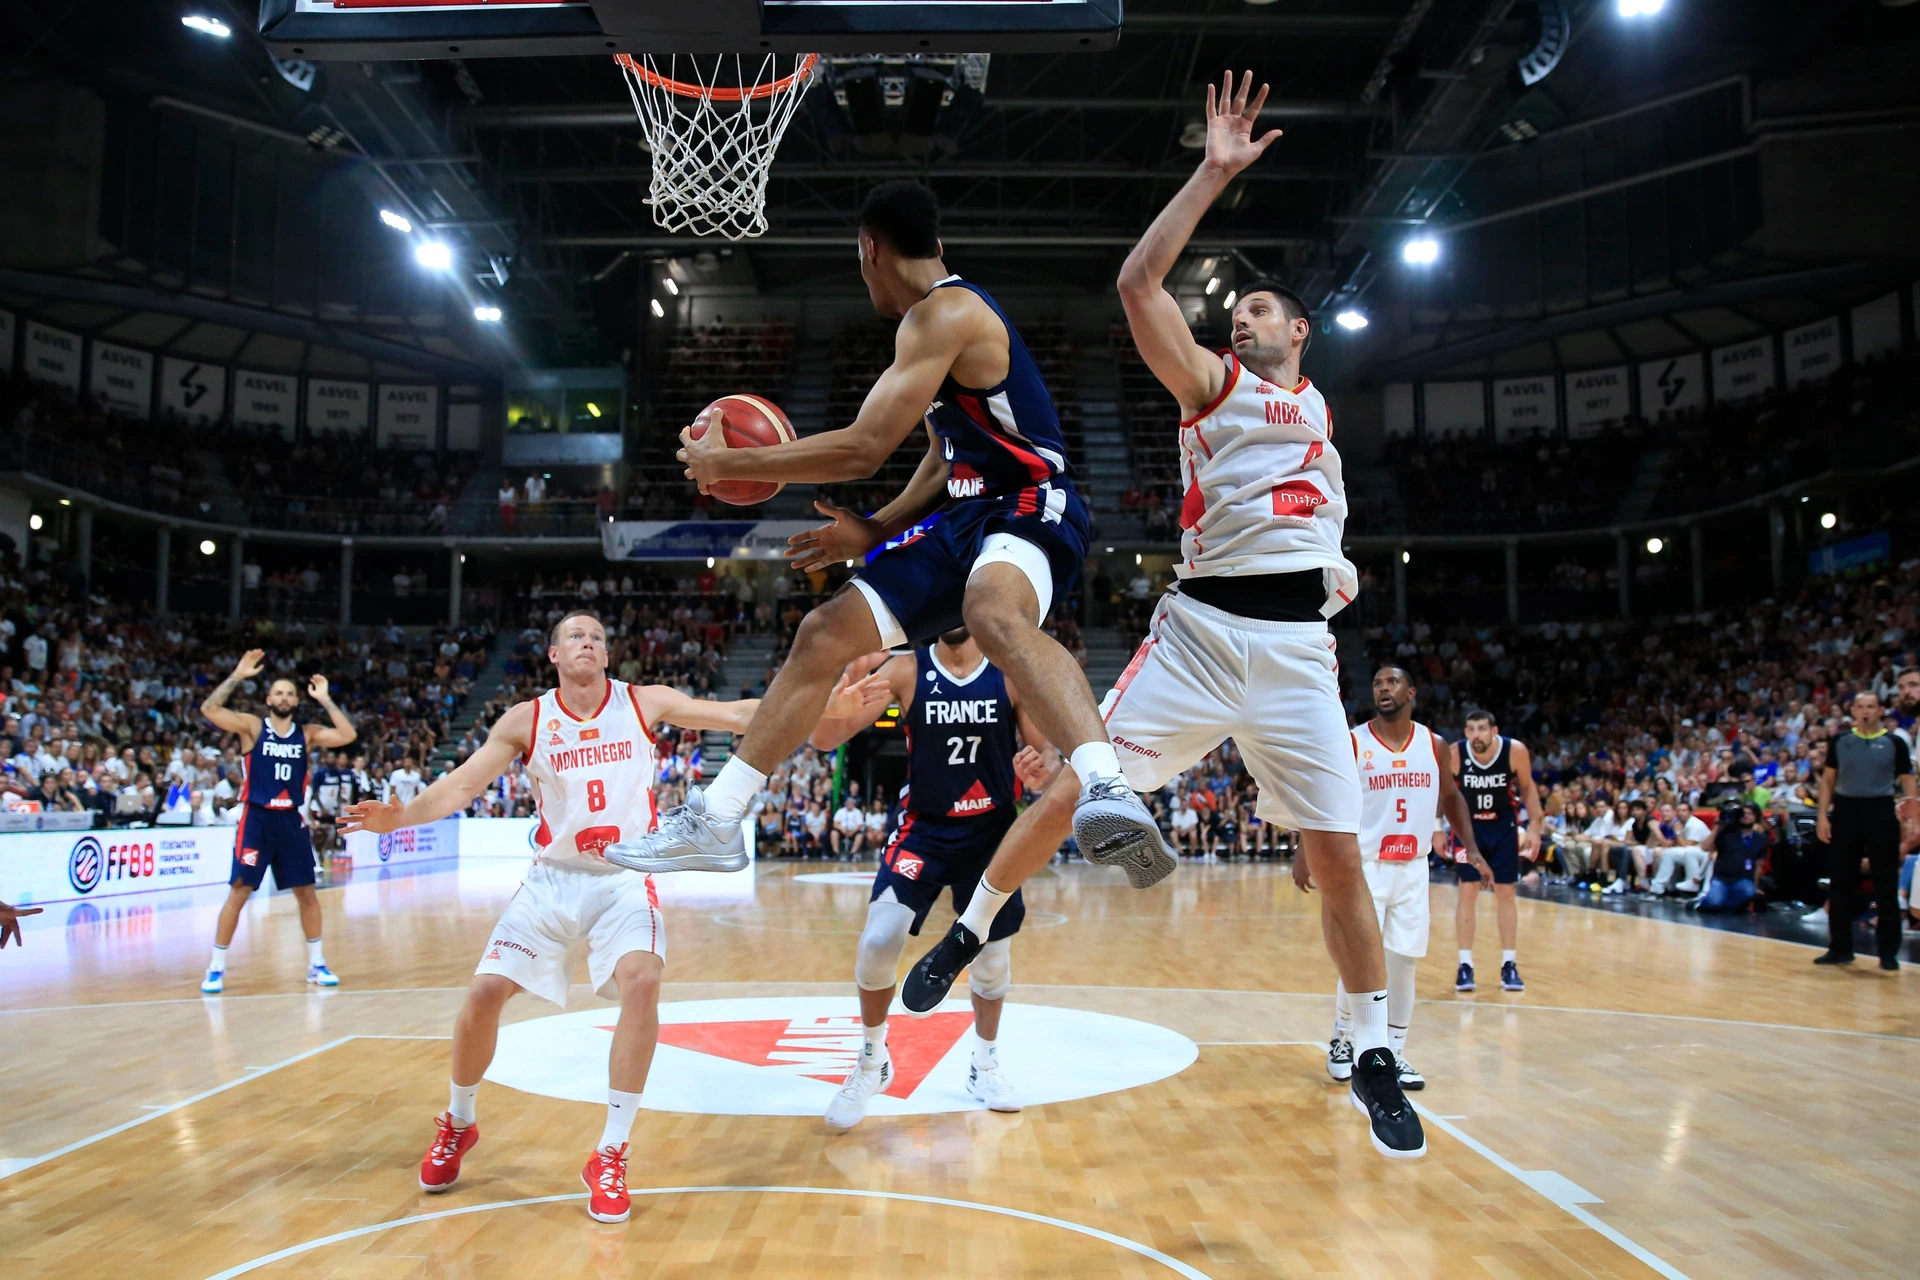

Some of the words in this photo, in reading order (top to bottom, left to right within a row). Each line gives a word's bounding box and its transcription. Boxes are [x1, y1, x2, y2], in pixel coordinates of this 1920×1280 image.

[1793, 326, 1834, 348] ASVEL
[101, 349, 142, 371] ASVEL
[1721, 346, 1763, 365] ASVEL
[244, 377, 289, 394] ASVEL
[1502, 382, 1547, 396] ASVEL
[1575, 374, 1619, 390] ASVEL
[317, 386, 361, 402] ASVEL
[387, 391, 429, 404] ASVEL
[947, 477, 984, 498] MAIF
[925, 699, 998, 724] FRANCE
[262, 742, 302, 759] FRANCE
[550, 740, 632, 773] MONTENEGRO
[946, 735, 982, 765] 27
[1112, 736, 1162, 759] BEMAX
[274, 763, 292, 781] 10
[1368, 772, 1431, 791] MONTENEGRO
[1464, 773, 1507, 789] FRANCE
[587, 779, 606, 813] 8
[954, 796, 992, 813] MAIF
[1477, 794, 1493, 809] 18
[1396, 798, 1407, 823] 5
[494, 940, 537, 959] BEMAX
